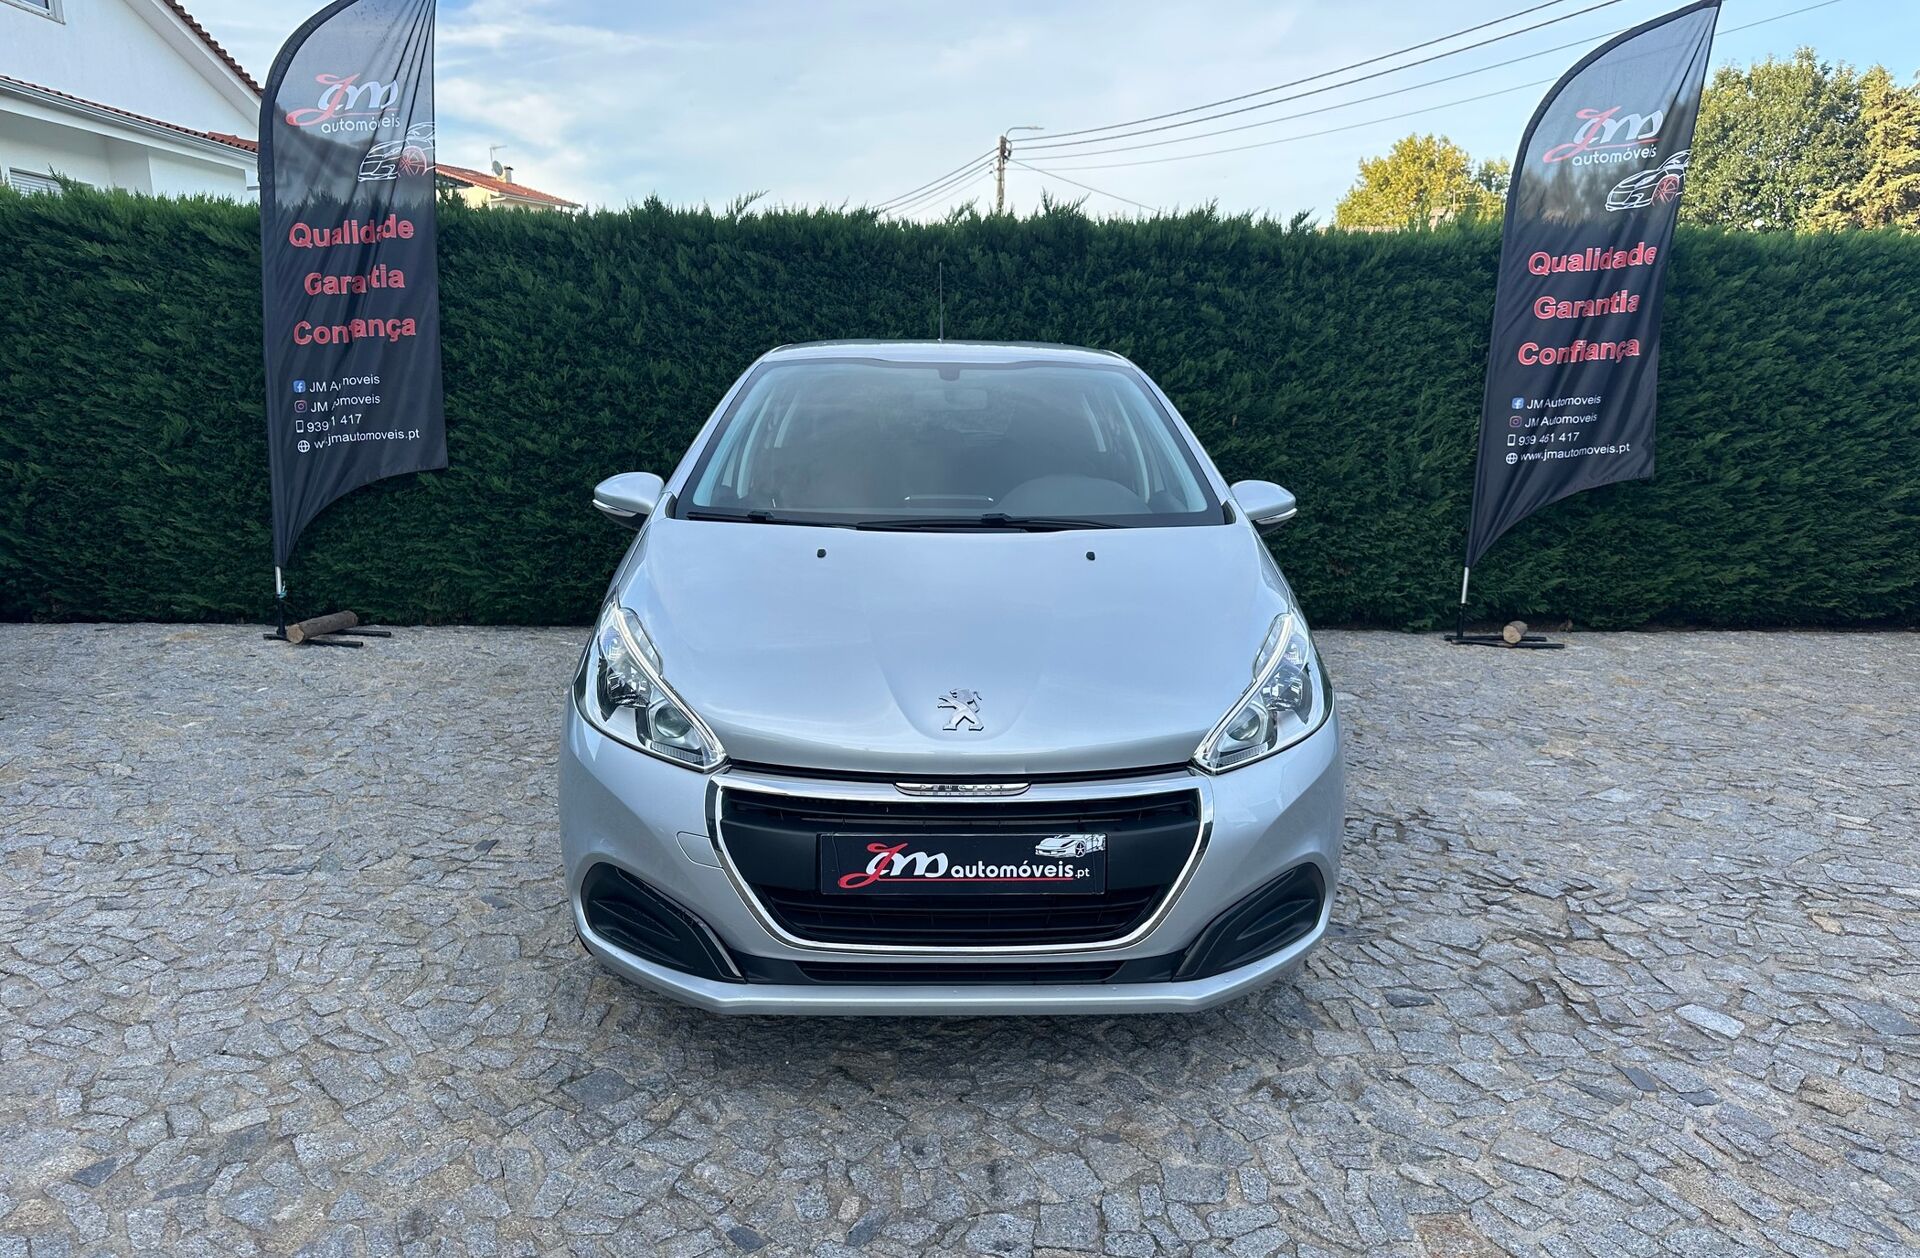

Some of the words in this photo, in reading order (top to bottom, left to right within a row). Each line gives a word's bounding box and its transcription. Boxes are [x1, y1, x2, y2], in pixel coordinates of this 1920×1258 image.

[1572, 144, 1657, 166] automóveis
[1528, 242, 1657, 276] Qualidade
[304, 264, 406, 296] Garatia
[1533, 290, 1640, 320] Garantia
[293, 318, 417, 345] Conança
[1518, 338, 1640, 366] Confiança
[309, 381, 327, 393] JM
[310, 401, 328, 413] JM
[1526, 399, 1544, 410] JM
[1544, 394, 1601, 408] Automoveis
[306, 420, 329, 433] 939
[340, 413, 362, 425] 417
[1524, 417, 1539, 428] JM
[1540, 412, 1598, 427] Automoveis
[1518, 434, 1537, 447] 939
[1558, 431, 1580, 442] 417
[1520, 442, 1630, 462] www.jmautomoveis.pt
